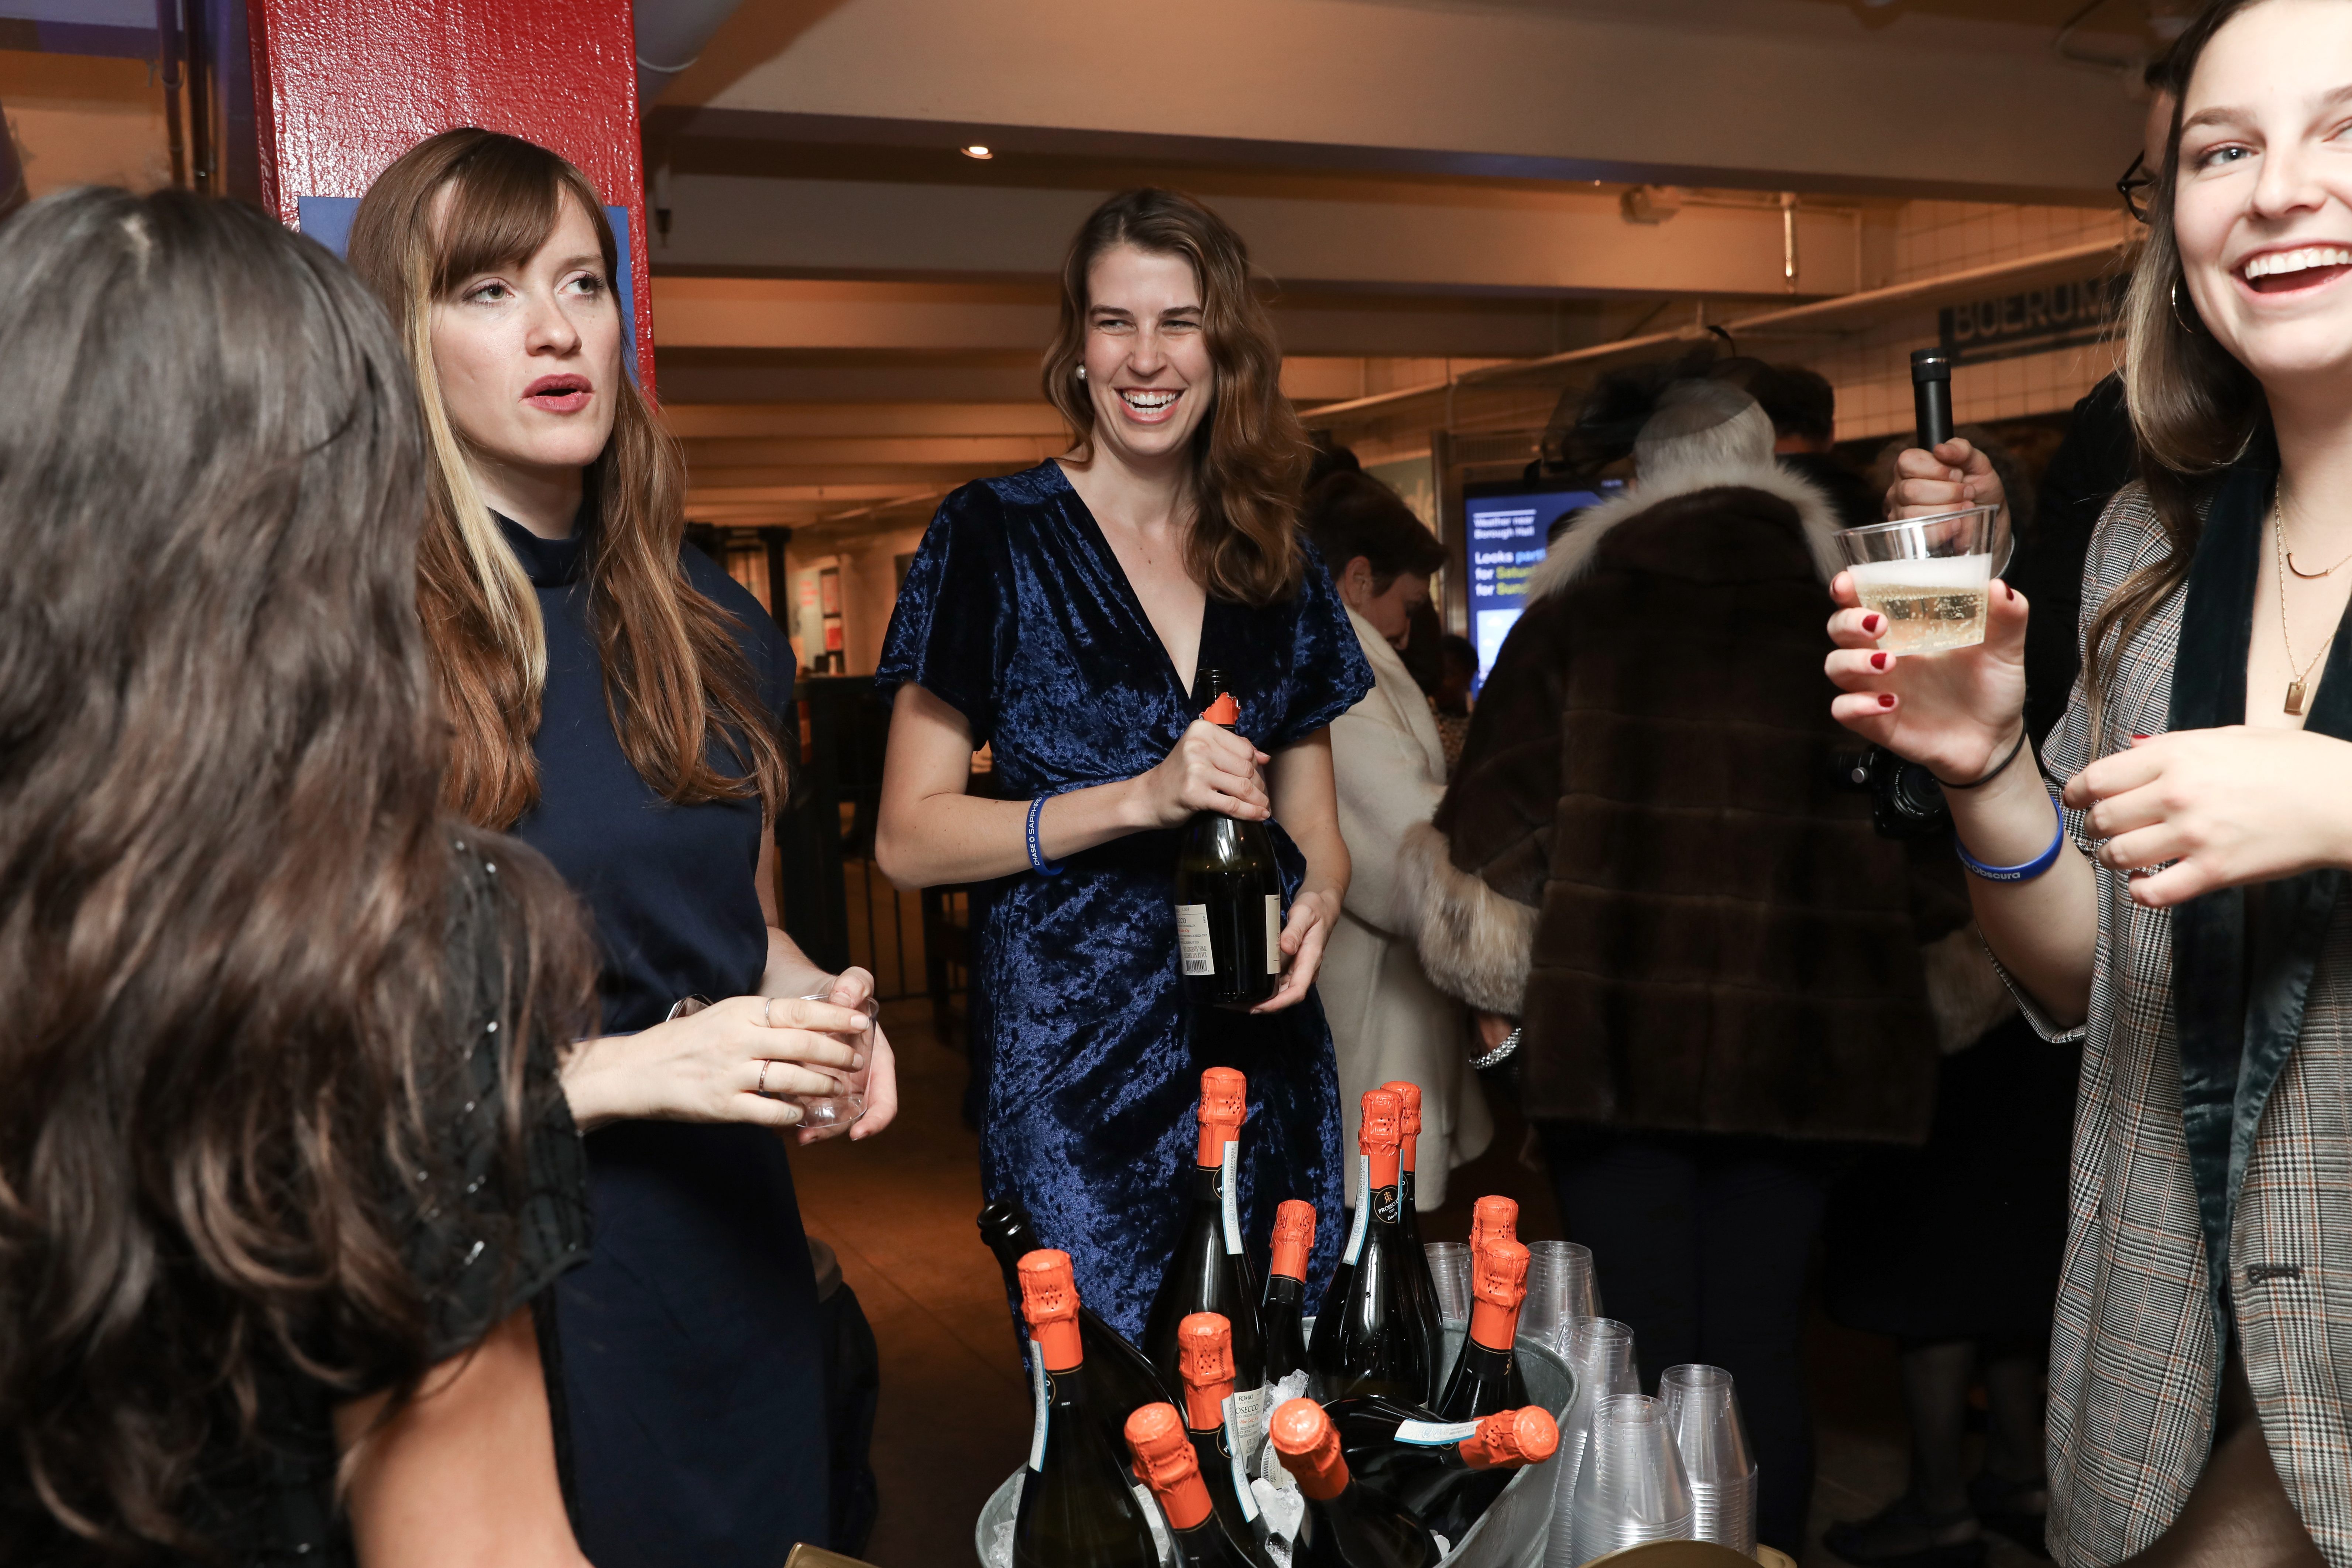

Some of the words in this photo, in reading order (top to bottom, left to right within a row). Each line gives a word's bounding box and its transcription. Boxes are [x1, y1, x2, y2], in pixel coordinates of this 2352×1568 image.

[1953, 279, 2110, 342] BOERUM
[1473, 518, 1511, 528] Weather
[1513, 517, 1535, 525] near
[1474, 528, 1514, 540] Borough
[1515, 526, 1535, 536] Hall
[1475, 550, 1514, 564] Looks
[1475, 567, 1494, 580] for
[1475, 583, 1495, 596] for
[1030, 844, 1040, 865] CHASE
[1971, 865, 2020, 879] Obscura
[1378, 1198, 1398, 1214] PROSECCO
[1235, 1403, 1259, 1414] OSECCO
